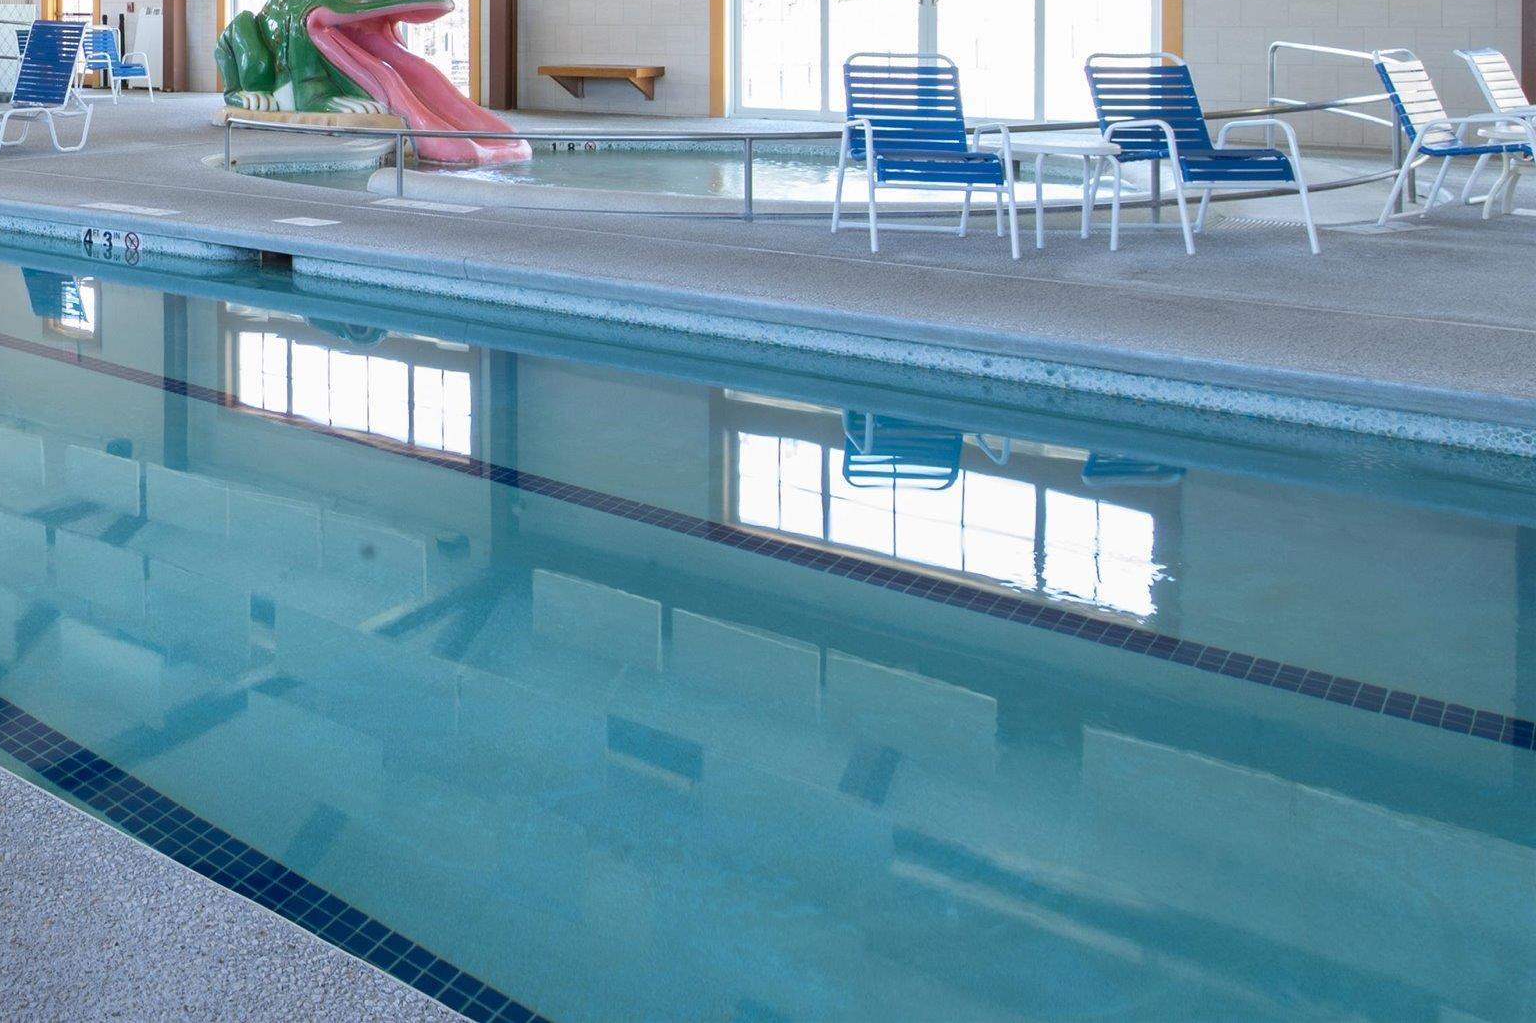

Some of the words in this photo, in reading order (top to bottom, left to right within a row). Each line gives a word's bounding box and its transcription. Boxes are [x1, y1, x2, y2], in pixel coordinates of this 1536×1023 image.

[567, 142, 575, 151] 8
[84, 228, 93, 243] 4
[103, 231, 112, 247] 3
